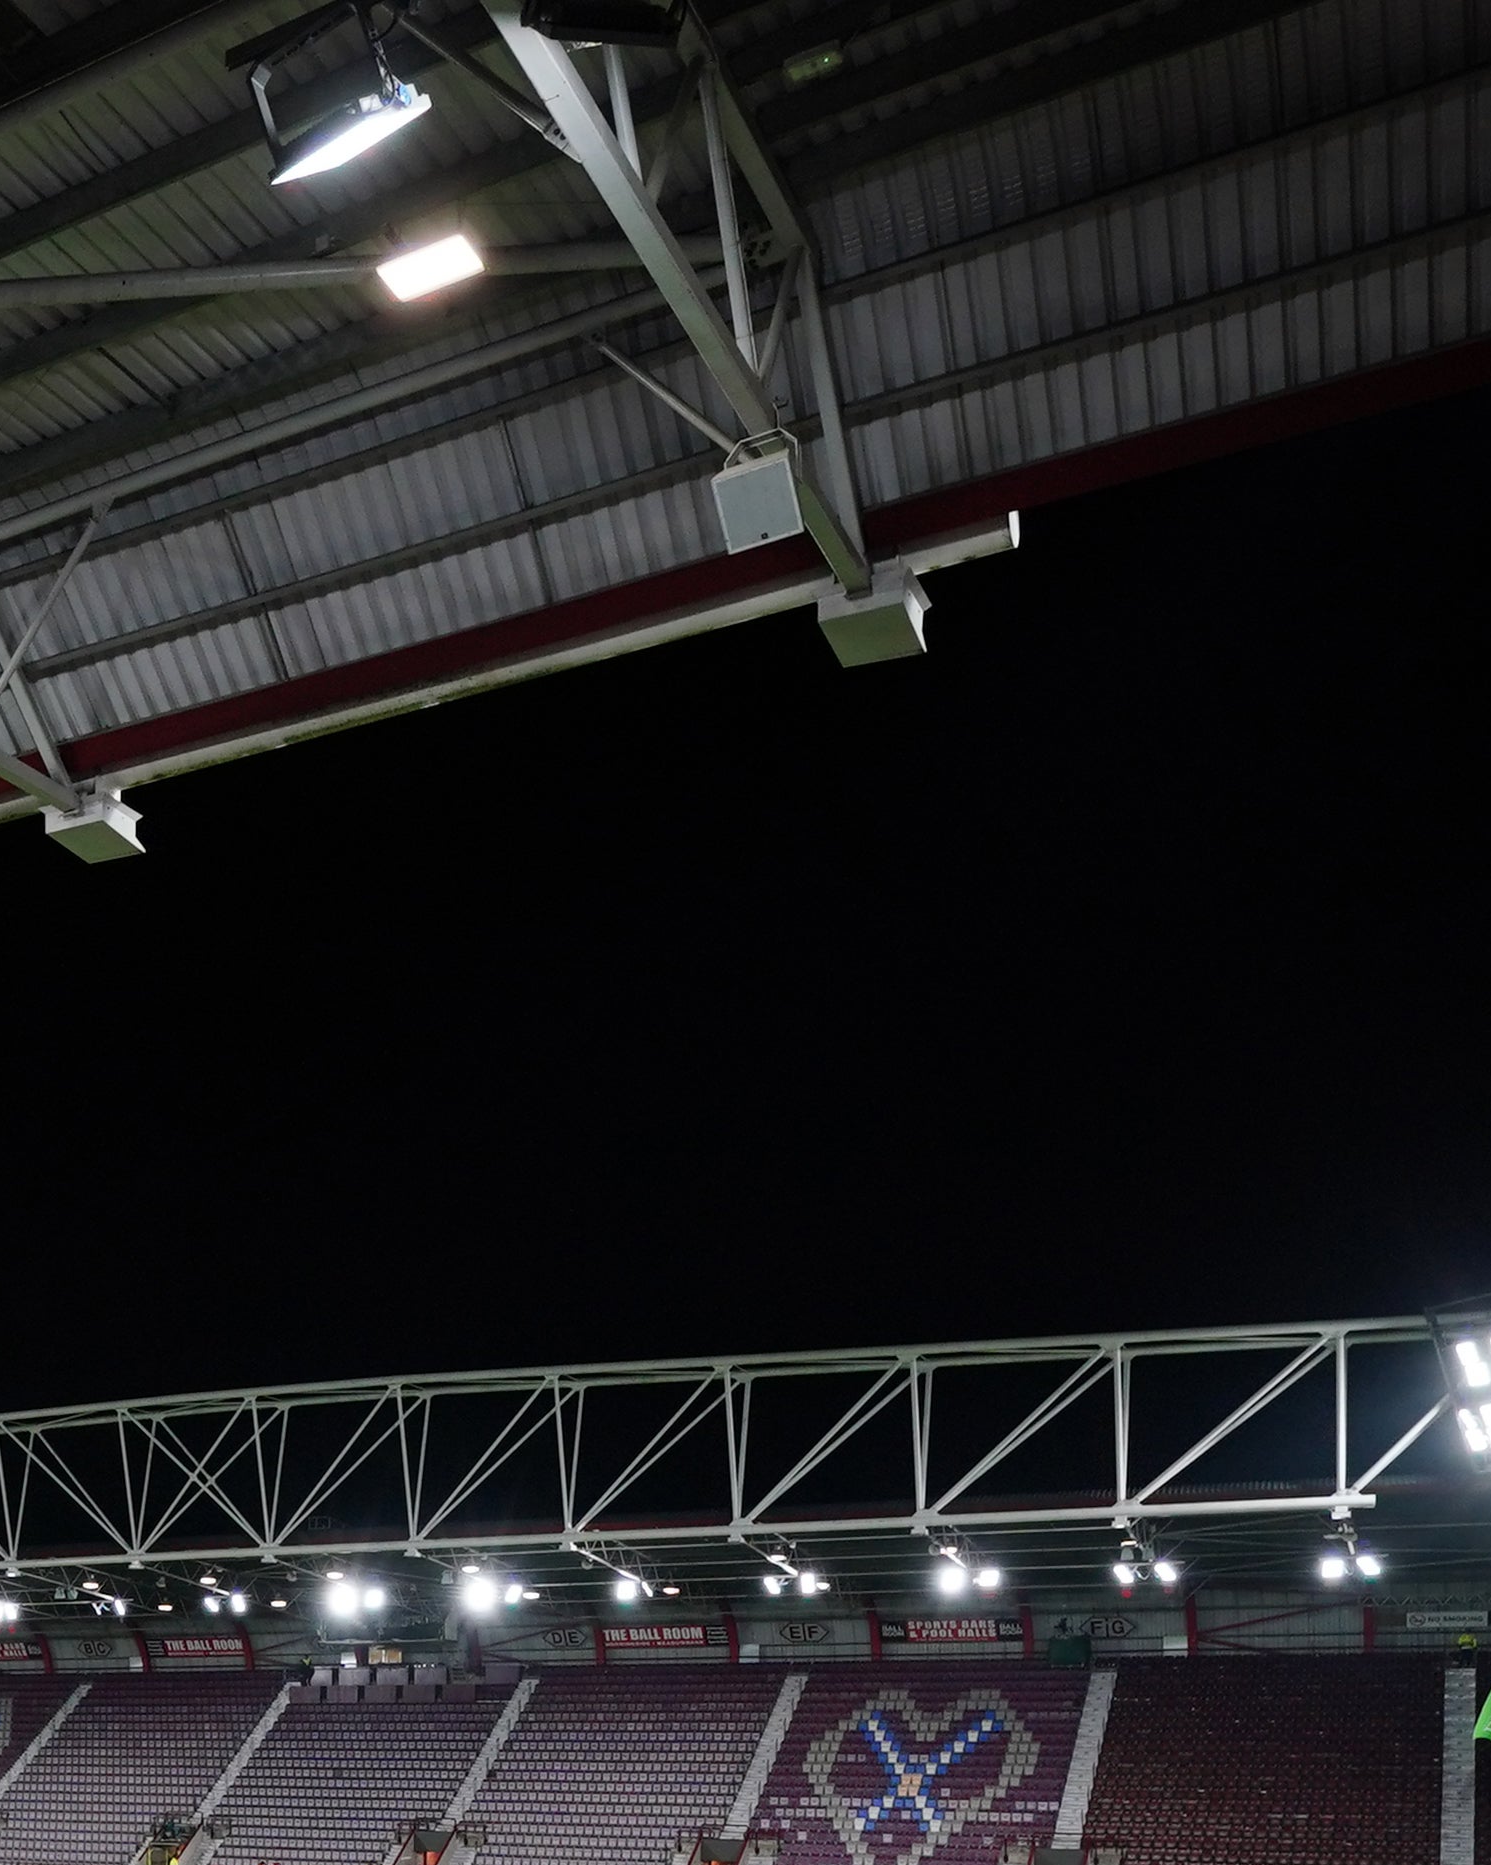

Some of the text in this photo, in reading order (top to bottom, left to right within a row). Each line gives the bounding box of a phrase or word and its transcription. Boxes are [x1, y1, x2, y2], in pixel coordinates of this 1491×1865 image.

[789, 1625, 819, 1639] E F
[1090, 1620, 1125, 1635] F G
[552, 1632, 579, 1644] D E
[603, 1629, 628, 1642] THE
[629, 1628, 661, 1641] BALL
[662, 1627, 703, 1640] ROOM
[83, 1642, 106, 1655] B C
[164, 1640, 185, 1651] THE
[186, 1640, 212, 1651] BALL
